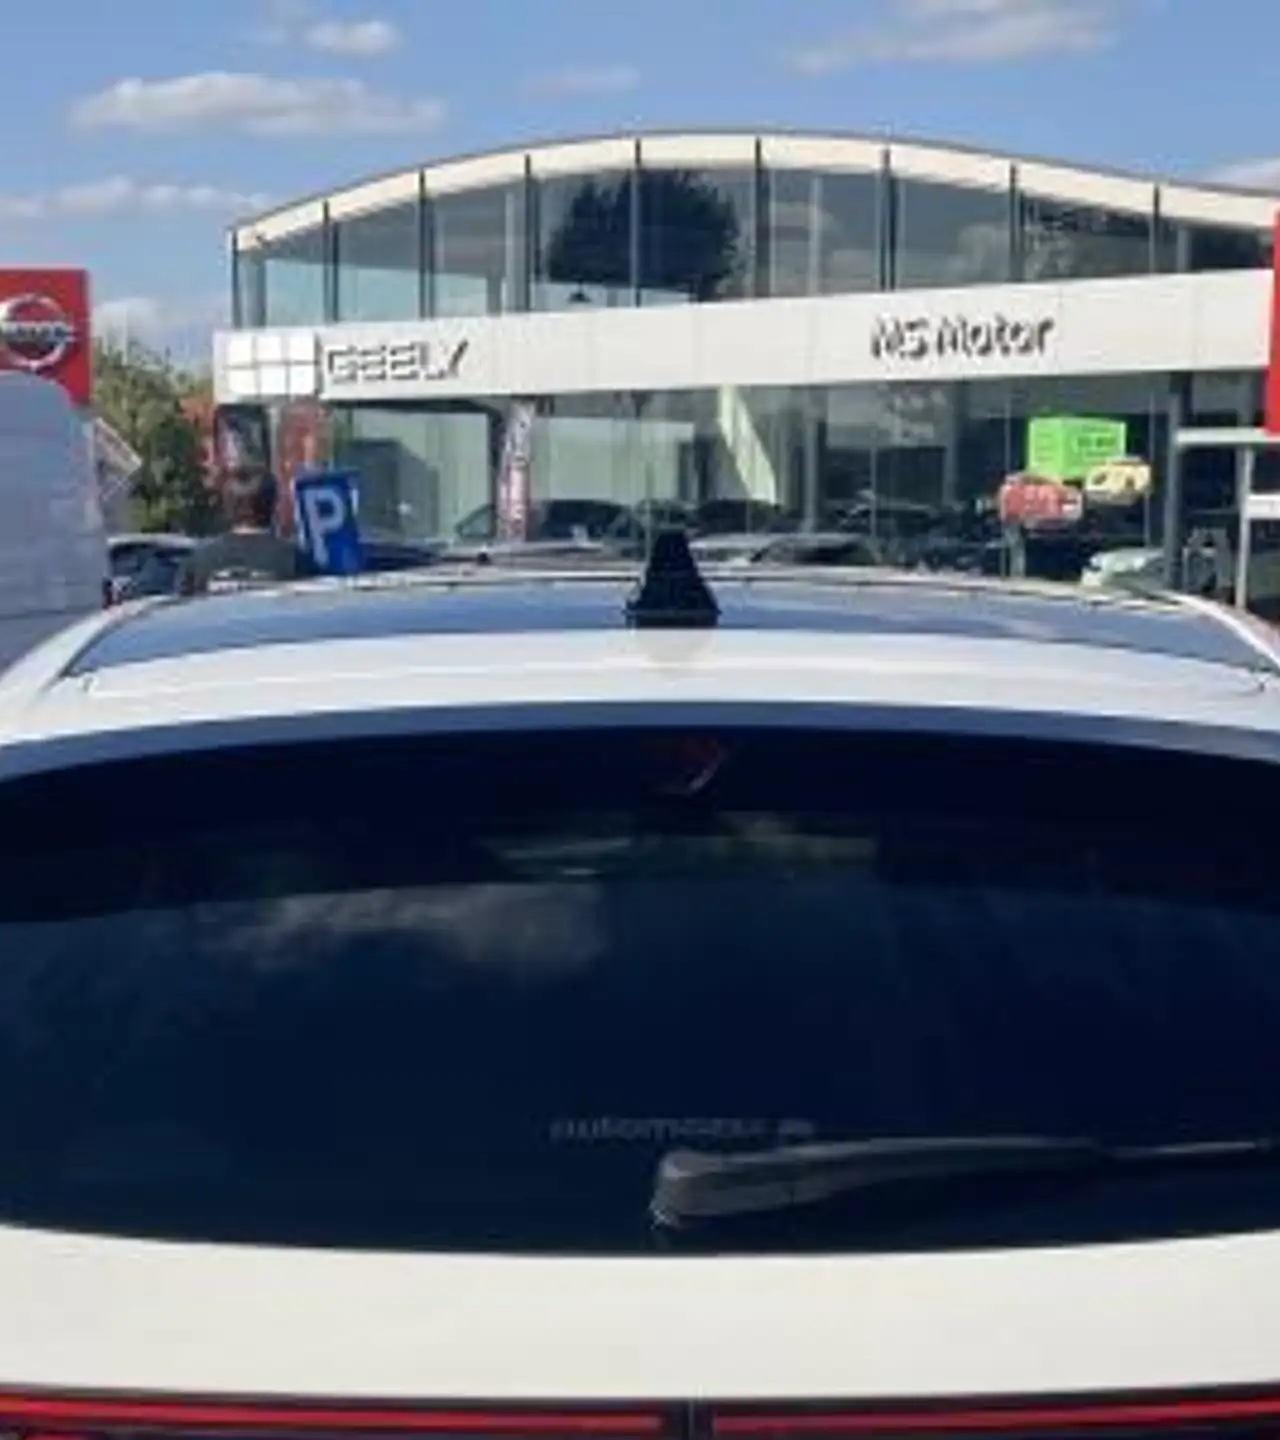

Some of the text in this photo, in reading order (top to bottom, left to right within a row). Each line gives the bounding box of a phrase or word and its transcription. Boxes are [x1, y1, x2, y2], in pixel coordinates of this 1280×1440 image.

[871, 313, 1055, 360] MS Motor
[327, 338, 469, 384] GEELY
[303, 489, 344, 567] P
